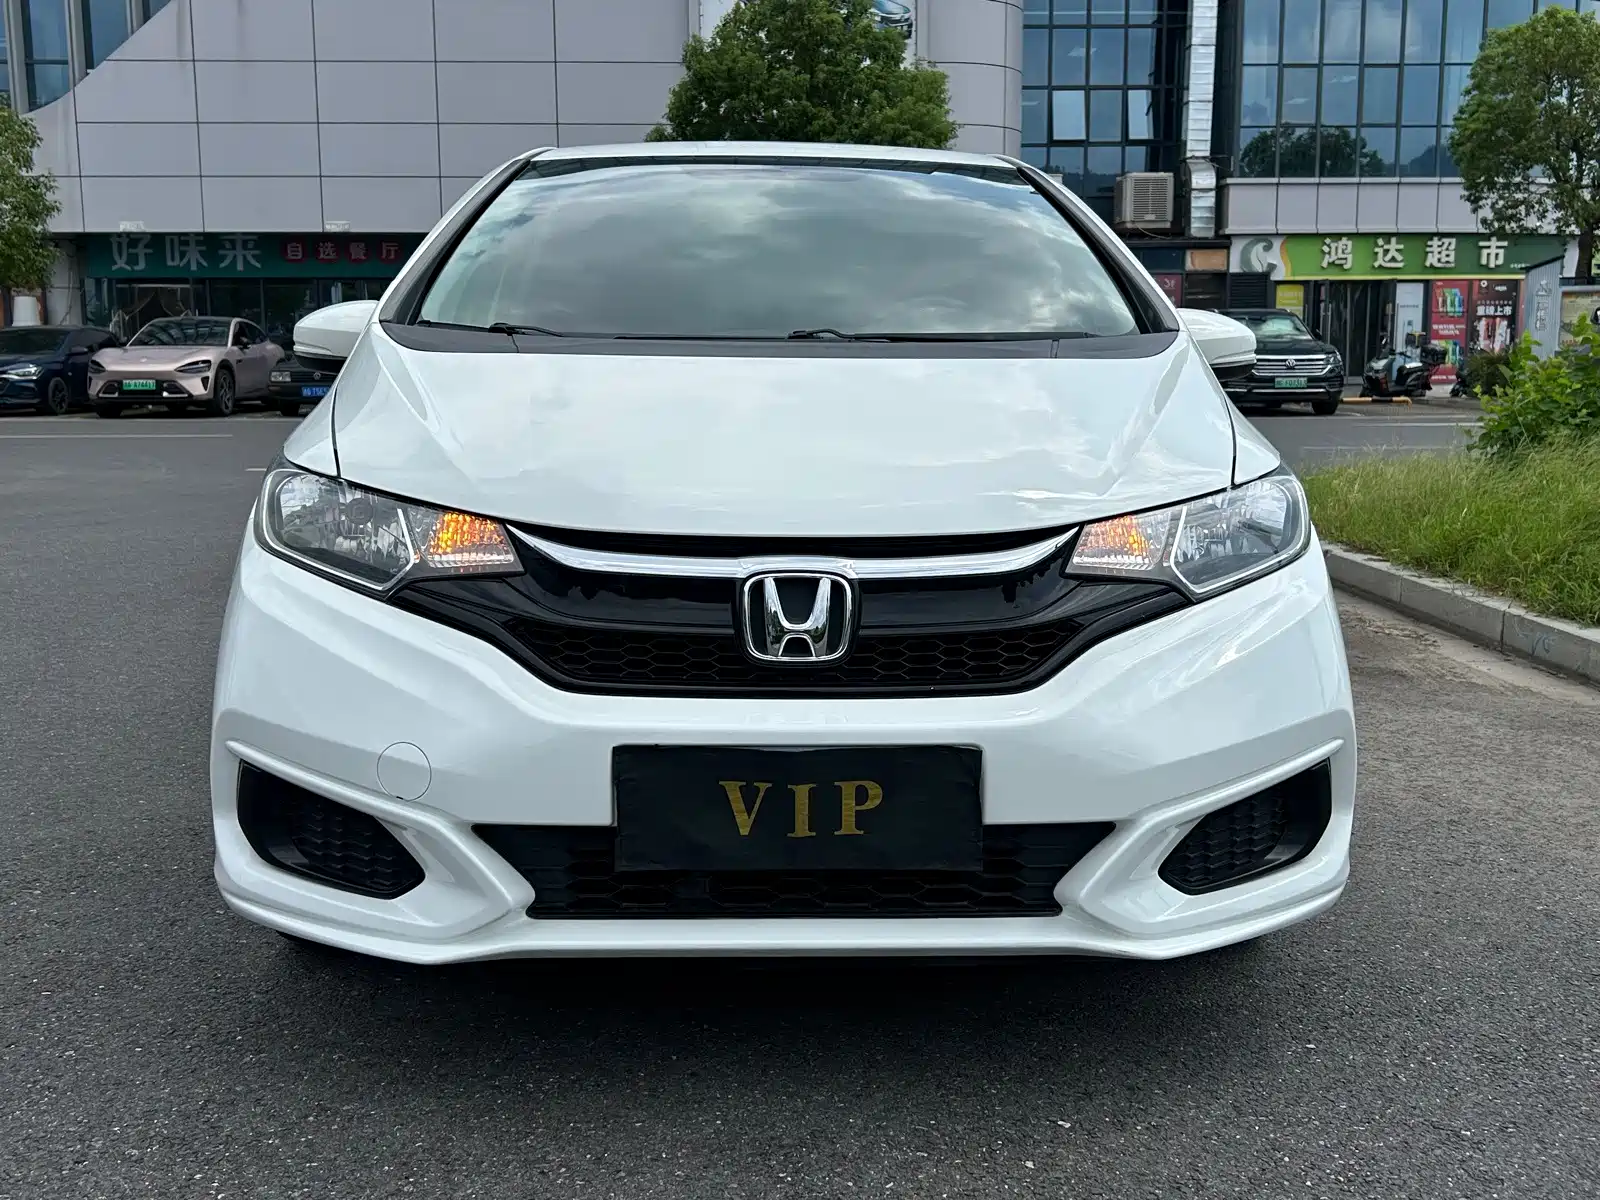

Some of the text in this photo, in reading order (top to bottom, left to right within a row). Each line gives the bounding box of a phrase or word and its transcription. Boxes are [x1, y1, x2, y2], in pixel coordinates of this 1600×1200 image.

[110, 232, 400, 271] 好味来 自选餐厅
[1320, 237, 1509, 270] 鸿达超市
[719, 780, 884, 838] VIP
